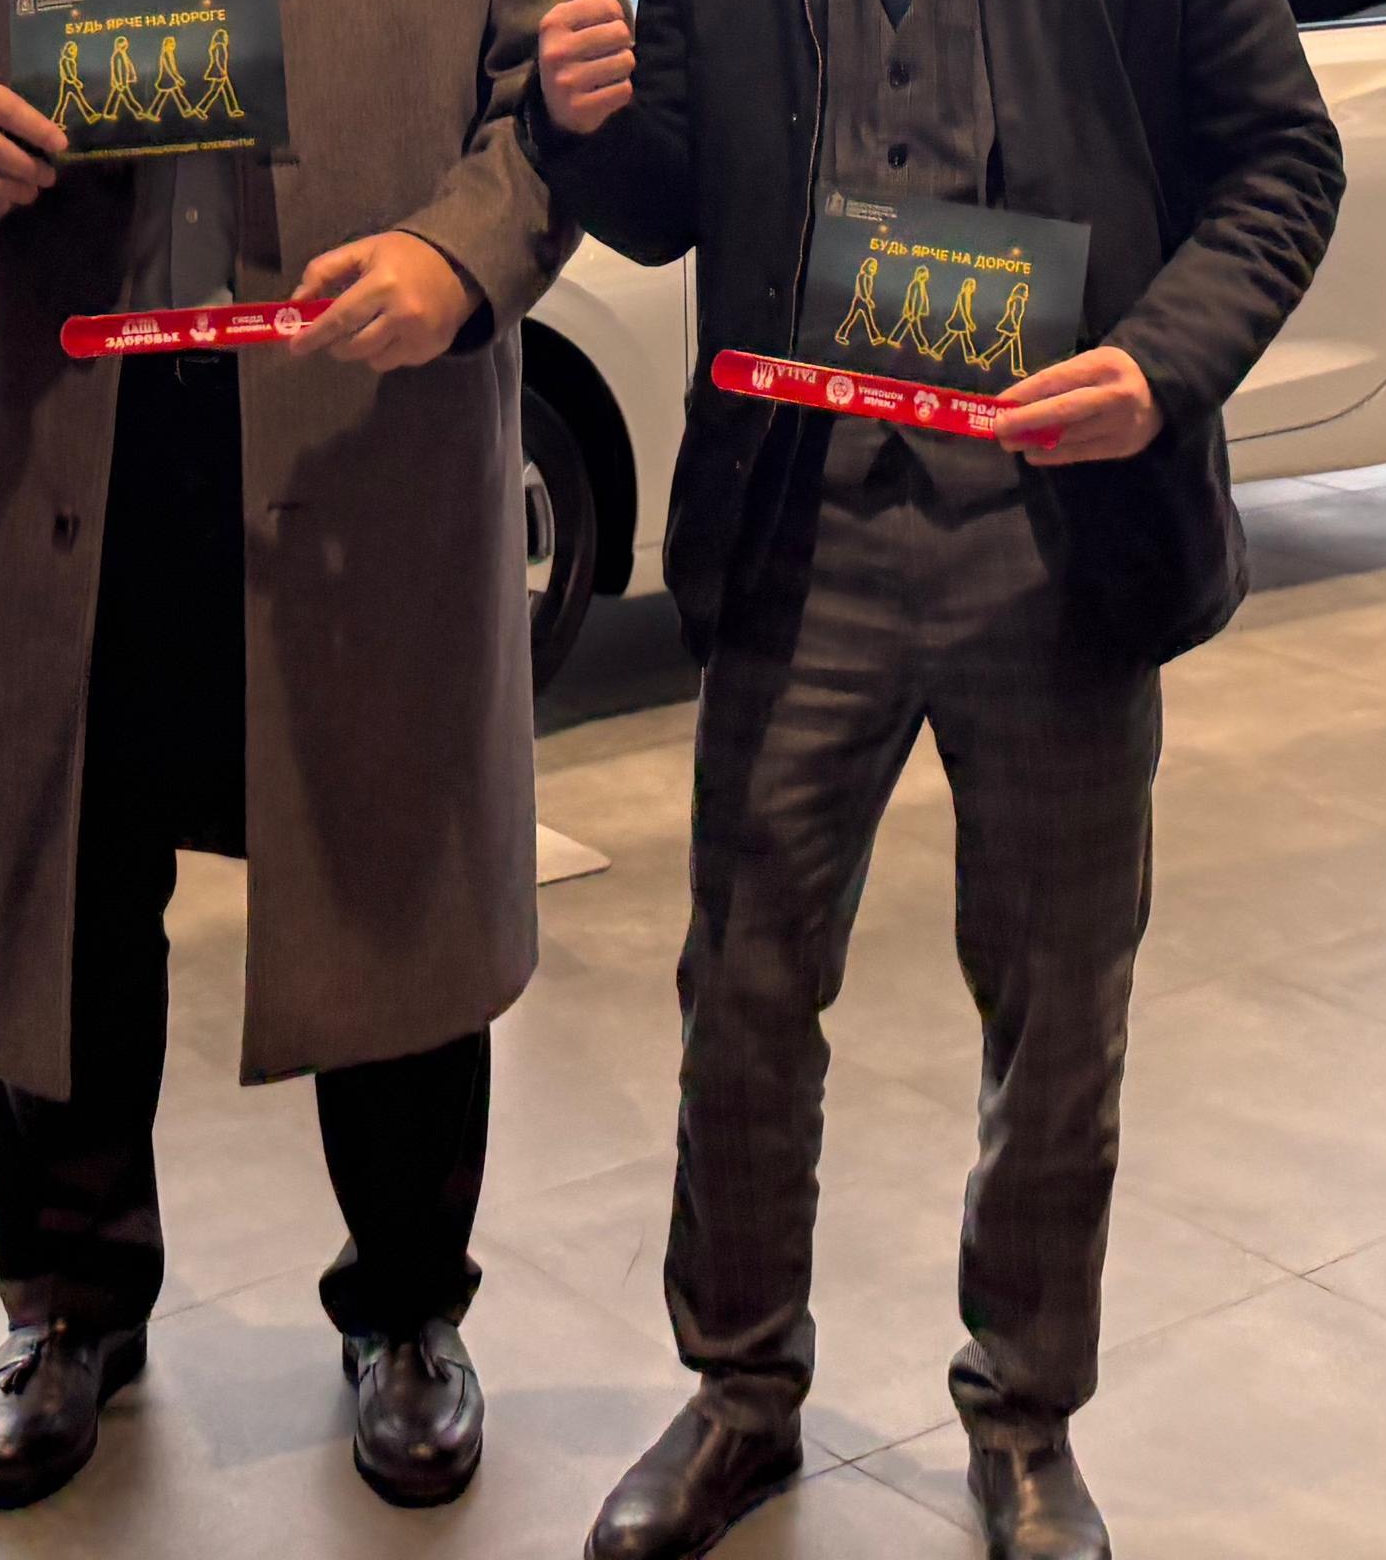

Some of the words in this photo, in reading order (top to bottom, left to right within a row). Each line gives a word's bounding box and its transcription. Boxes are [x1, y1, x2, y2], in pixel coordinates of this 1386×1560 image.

[65, 20, 103, 35] БУДЬ
[106, 15, 143, 31] ЯРЧЕ
[146, 14, 167, 27] НА
[169, 9, 227, 27] ДОРОГЕ
[869, 237, 909, 256] БУДЬ
[912, 244, 950, 262] ЯРЧЕ
[951, 250, 972, 265] НА
[974, 255, 1033, 276] ДОРОГЕ
[105, 331, 181, 350] ЗДОРОВЬЕ
